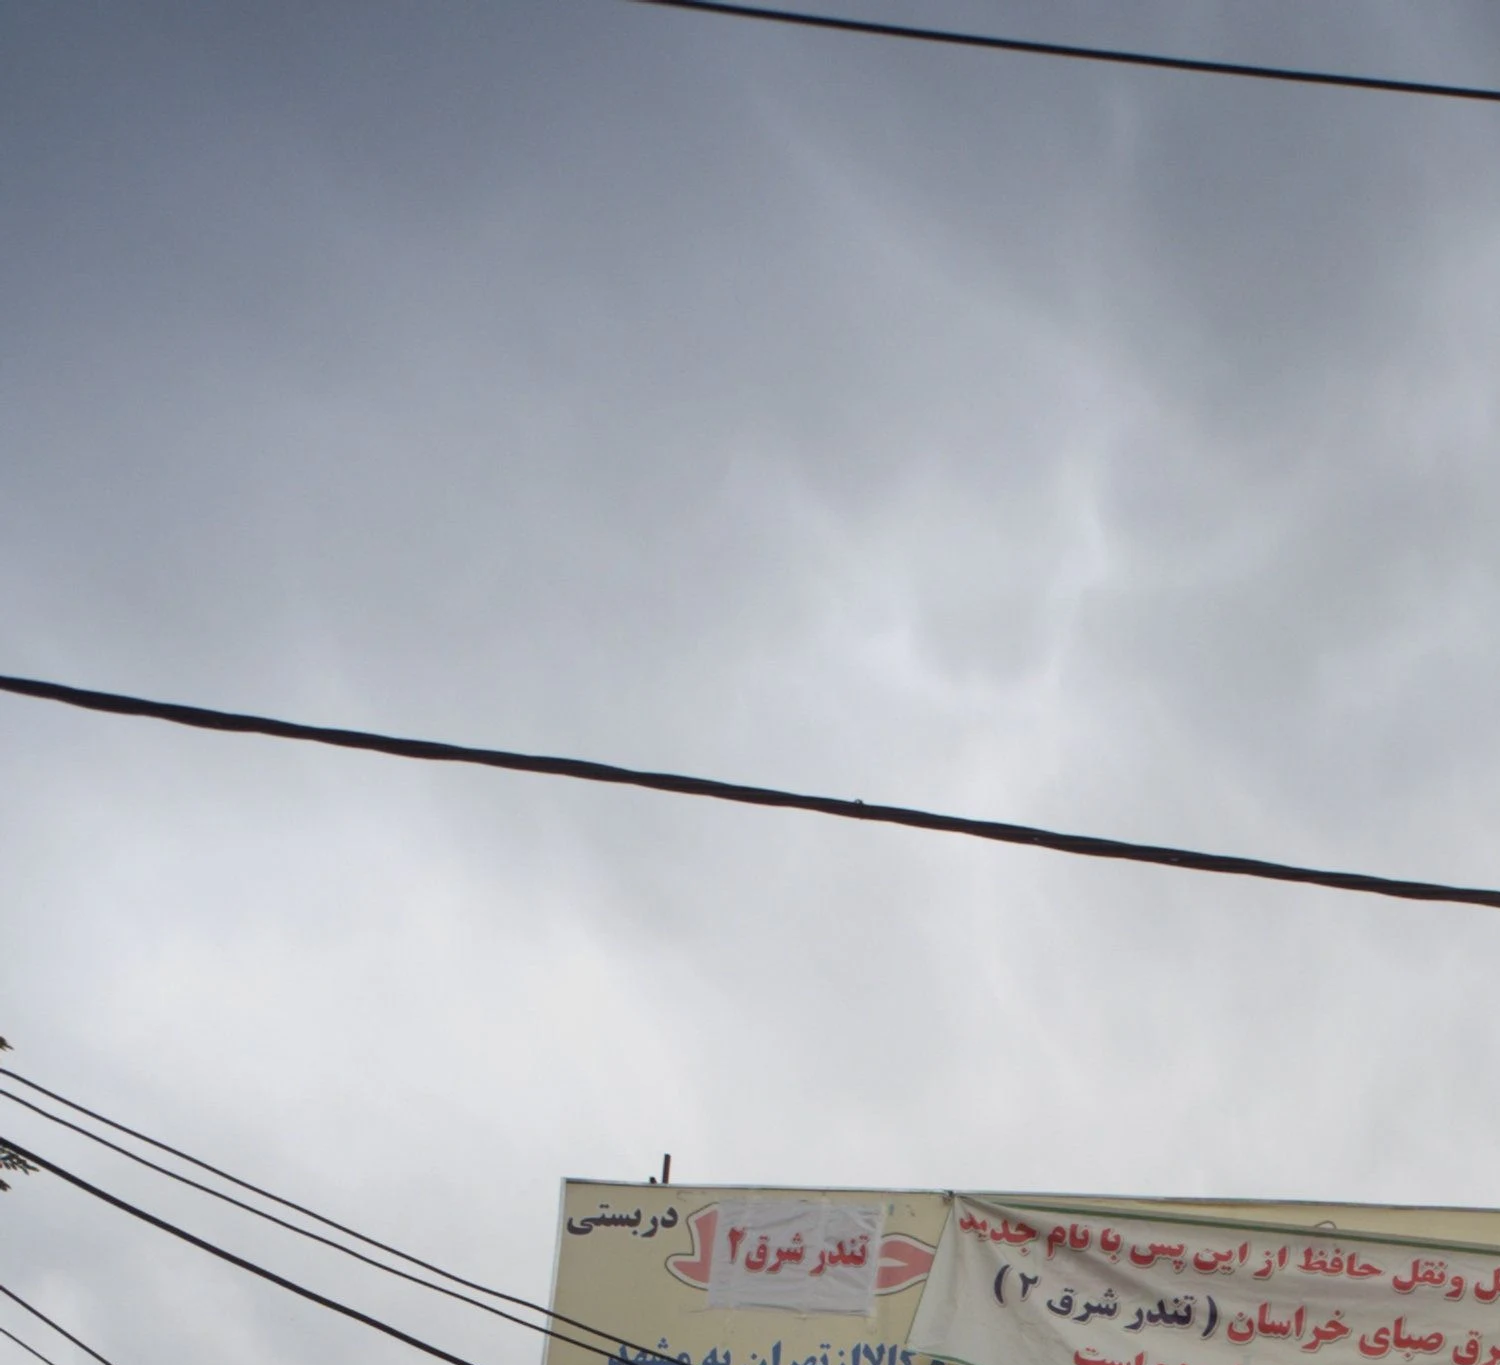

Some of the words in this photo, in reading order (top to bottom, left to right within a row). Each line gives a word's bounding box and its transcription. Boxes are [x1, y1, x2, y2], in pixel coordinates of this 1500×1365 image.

[566, 1203, 679, 1238] دربستی
[959, 1211, 1039, 1256] جدید
[744, 1233, 805, 1273] شرق
[808, 1234, 870, 1276] تندر
[1047, 1223, 1091, 1258] نام
[1100, 1226, 1123, 1263] با
[1129, 1242, 1186, 1270] پس
[1194, 1240, 1250, 1273] این
[1253, 1245, 1289, 1279] از
[1299, 1245, 1383, 1279] حافظ
[1046, 1288, 1118, 1323] شرق
[1226, 1300, 1351, 1354] خراسان
[1358, 1315, 1444, 1361] صبای
